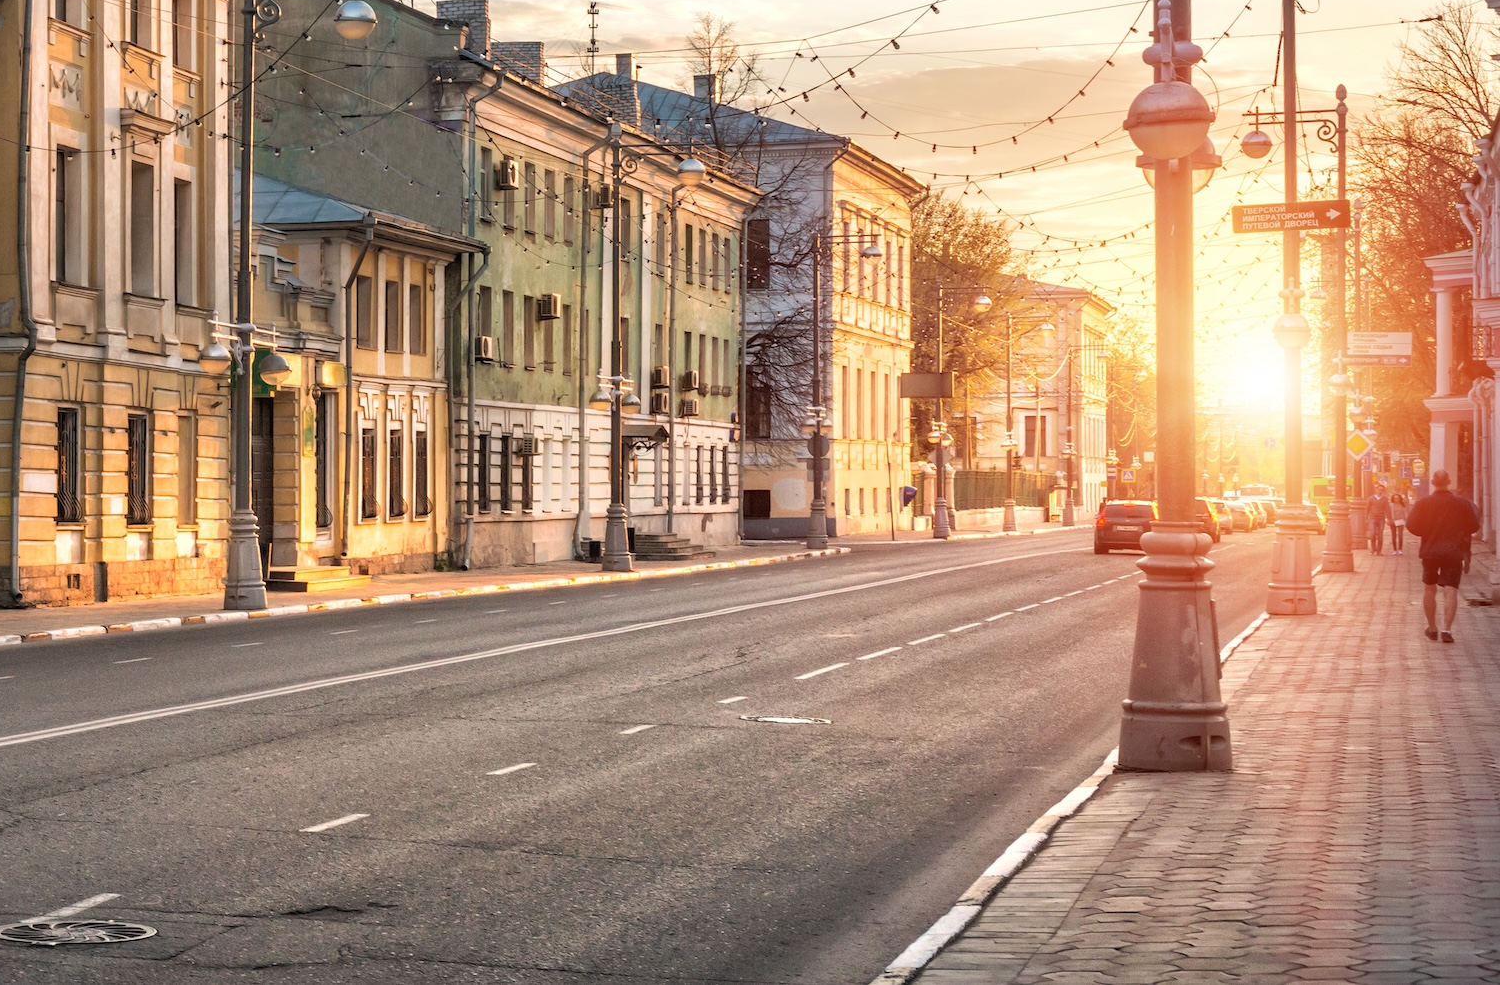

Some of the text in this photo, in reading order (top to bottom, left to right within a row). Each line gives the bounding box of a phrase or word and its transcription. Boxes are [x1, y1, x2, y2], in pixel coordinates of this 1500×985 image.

[1243, 206, 1286, 215] ТВЕРСКОЙ
[1242, 211, 1315, 222] ИМПЕРАТОРСКИЙ
[1242, 219, 1319, 230] ПУТЕВОЙ ДВОРЕЦ
